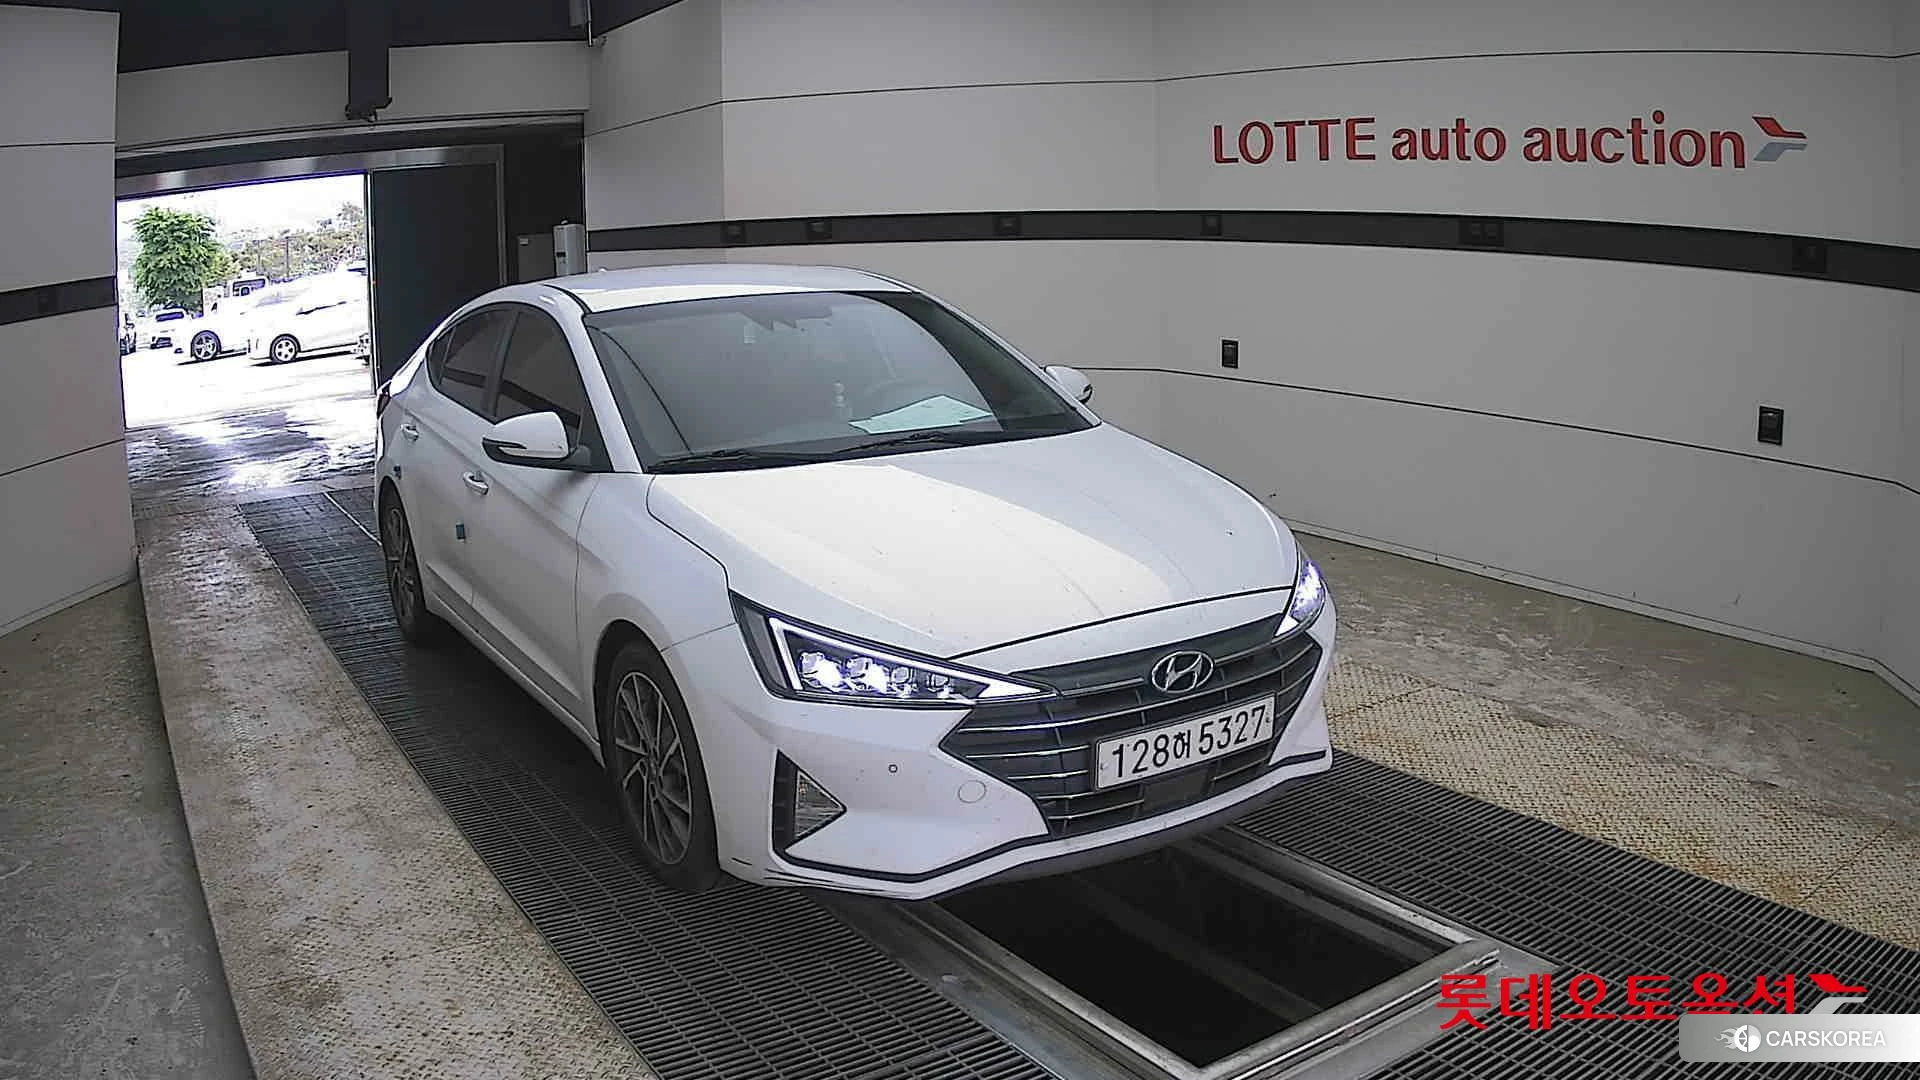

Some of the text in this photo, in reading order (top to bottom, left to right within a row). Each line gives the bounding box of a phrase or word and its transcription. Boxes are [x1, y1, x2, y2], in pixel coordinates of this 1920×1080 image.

[1213, 110, 1746, 168] LOTTE auto auction
